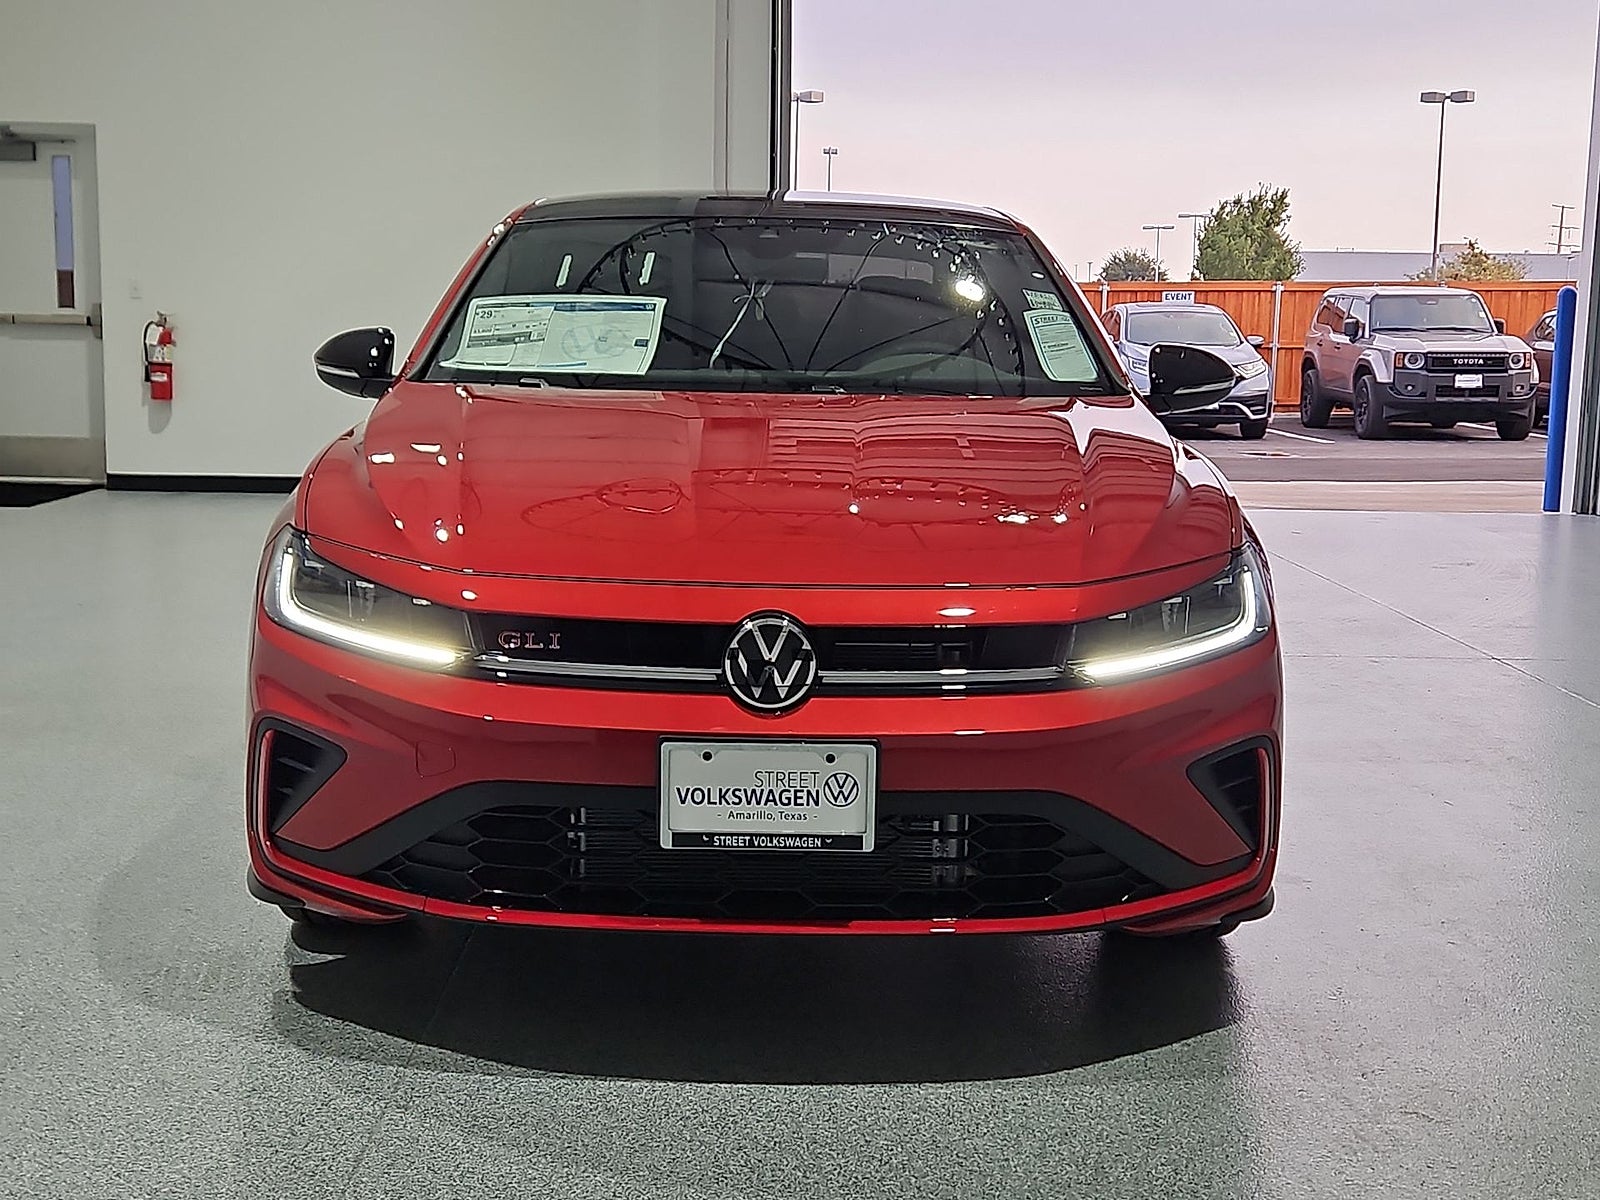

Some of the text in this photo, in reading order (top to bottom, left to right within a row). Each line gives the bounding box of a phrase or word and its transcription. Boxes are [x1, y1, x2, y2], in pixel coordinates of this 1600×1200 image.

[1164, 292, 1193, 301] EVENT
[479, 310, 494, 319] 29
[498, 631, 561, 649] GLI
[754, 771, 820, 788] STREET
[675, 787, 821, 807] VOLKSWAGEN
[727, 811, 808, 822] Amarillo, Texas
[713, 836, 822, 847] STREET VOLKSWAGEN
